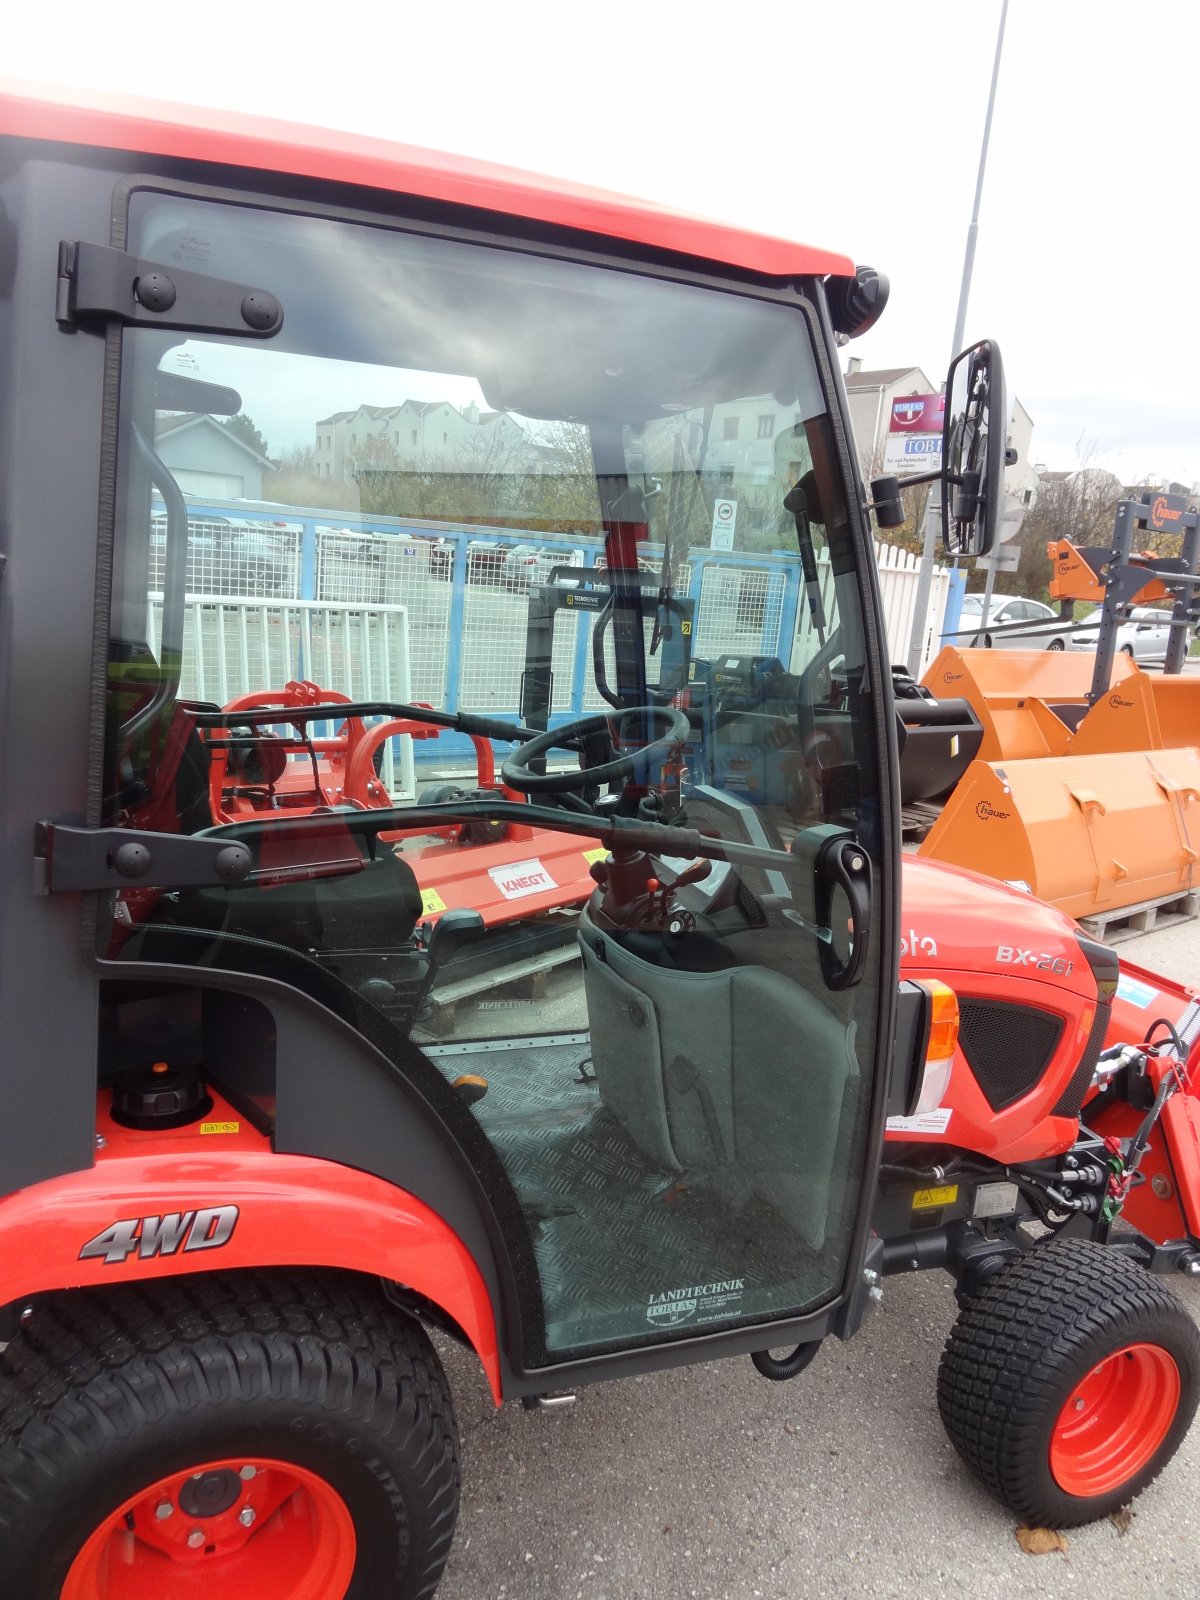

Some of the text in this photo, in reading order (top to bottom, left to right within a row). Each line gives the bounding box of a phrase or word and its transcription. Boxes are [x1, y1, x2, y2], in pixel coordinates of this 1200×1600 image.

[895, 402, 924, 413] TOBIAS
[1156, 502, 1182, 521] hauer
[1060, 563, 1080, 572] hauer
[946, 673, 964, 681] hauer
[1112, 697, 1134, 707] hauer
[980, 804, 1011, 819] hauer
[501, 873, 546, 892] KNEGT
[996, 945, 1075, 977] BX-261
[77, 1204, 240, 1265] 4WD
[648, 1278, 745, 1304] LANDTECHNIK
[648, 1299, 697, 1316] TOBIAS
[697, 1309, 742, 1323] www.tobias.at
